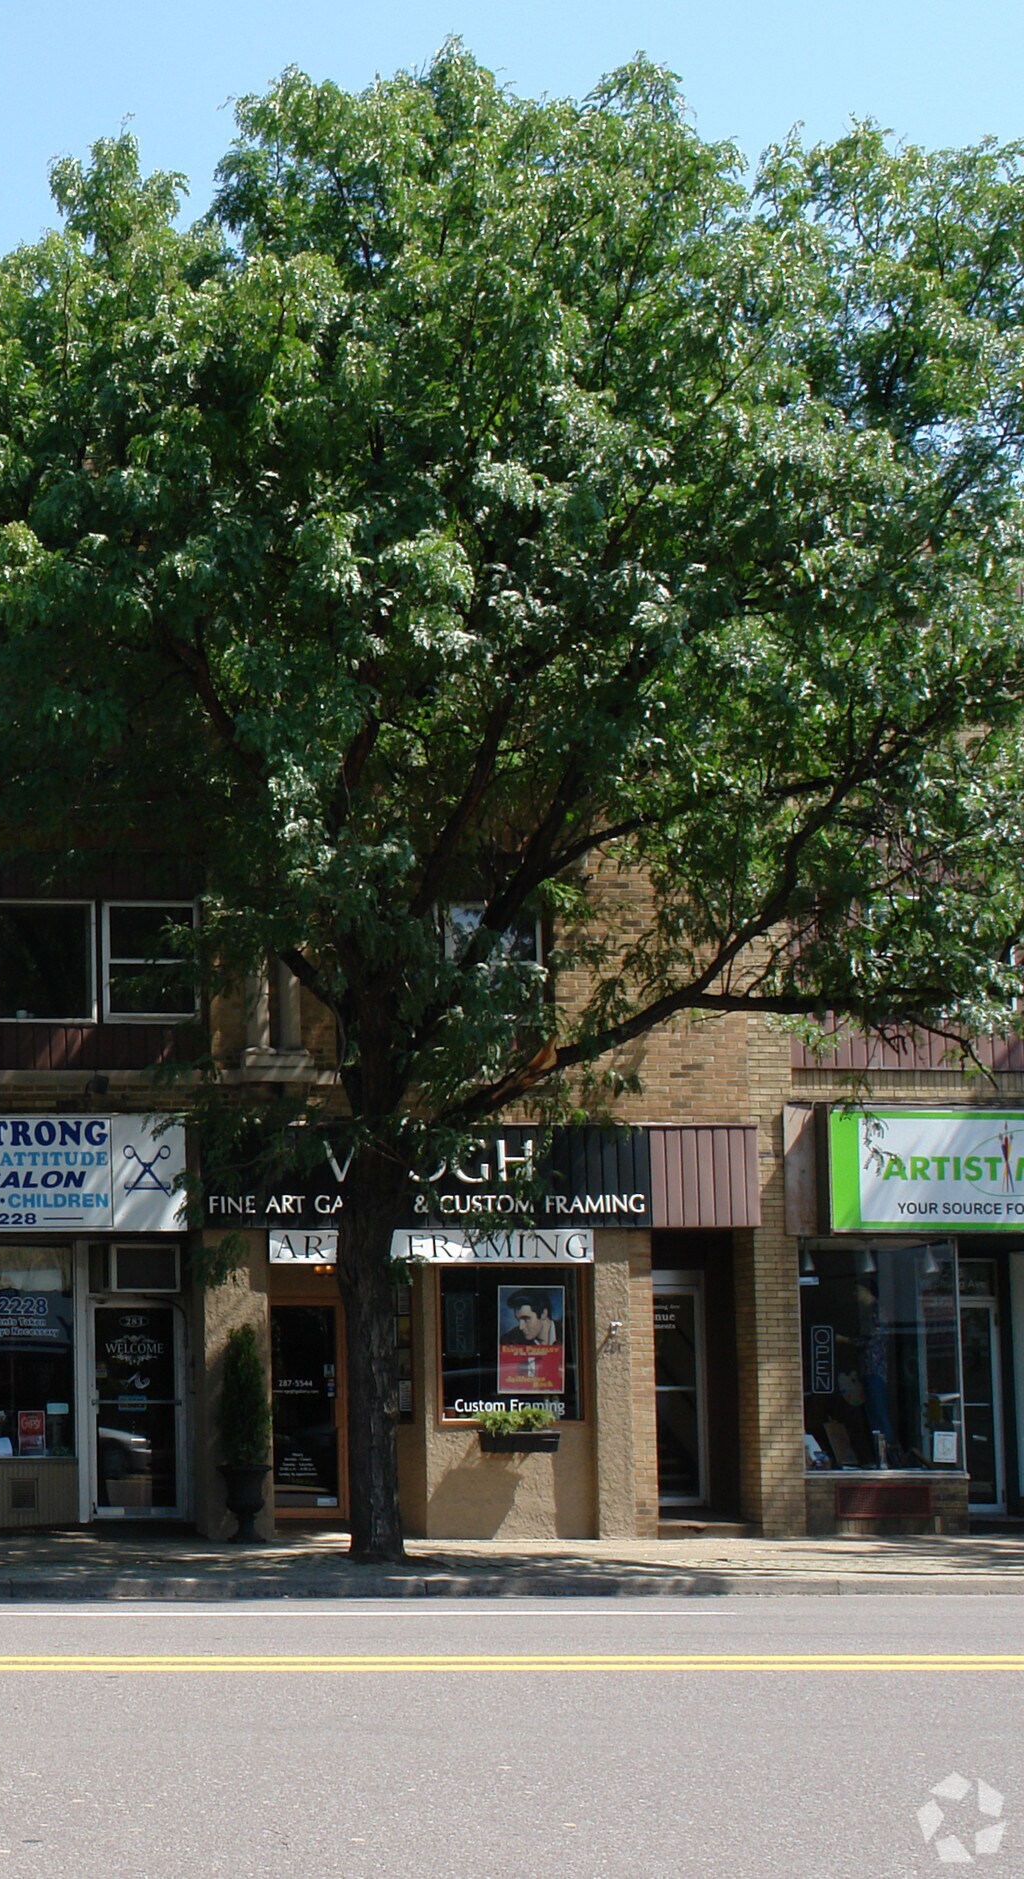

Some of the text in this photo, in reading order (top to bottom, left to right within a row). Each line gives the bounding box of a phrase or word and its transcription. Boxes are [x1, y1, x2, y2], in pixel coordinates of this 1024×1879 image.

[0, 1151, 109, 1167] ATTITUDE
[882, 1155, 1002, 1181] ARTIST
[7, 1193, 109, 1209] CHILDREN
[208, 1195, 256, 1214] FINE
[265, 1195, 306, 1214] ART
[413, 1193, 645, 1214] & CUSTOM FRAMING
[897, 1202, 1024, 1215] YOUR SOURCE FO
[405, 1233, 589, 1259] FRAMING
[17, 1316, 47, 1326] Taken
[453, 1300, 467, 1350] OPEN
[11, 1326, 60, 1338] Necessary
[105, 1343, 165, 1354] WELCOME
[814, 1329, 830, 1391] OPEN
[454, 1398, 565, 1416] Custom Framing
